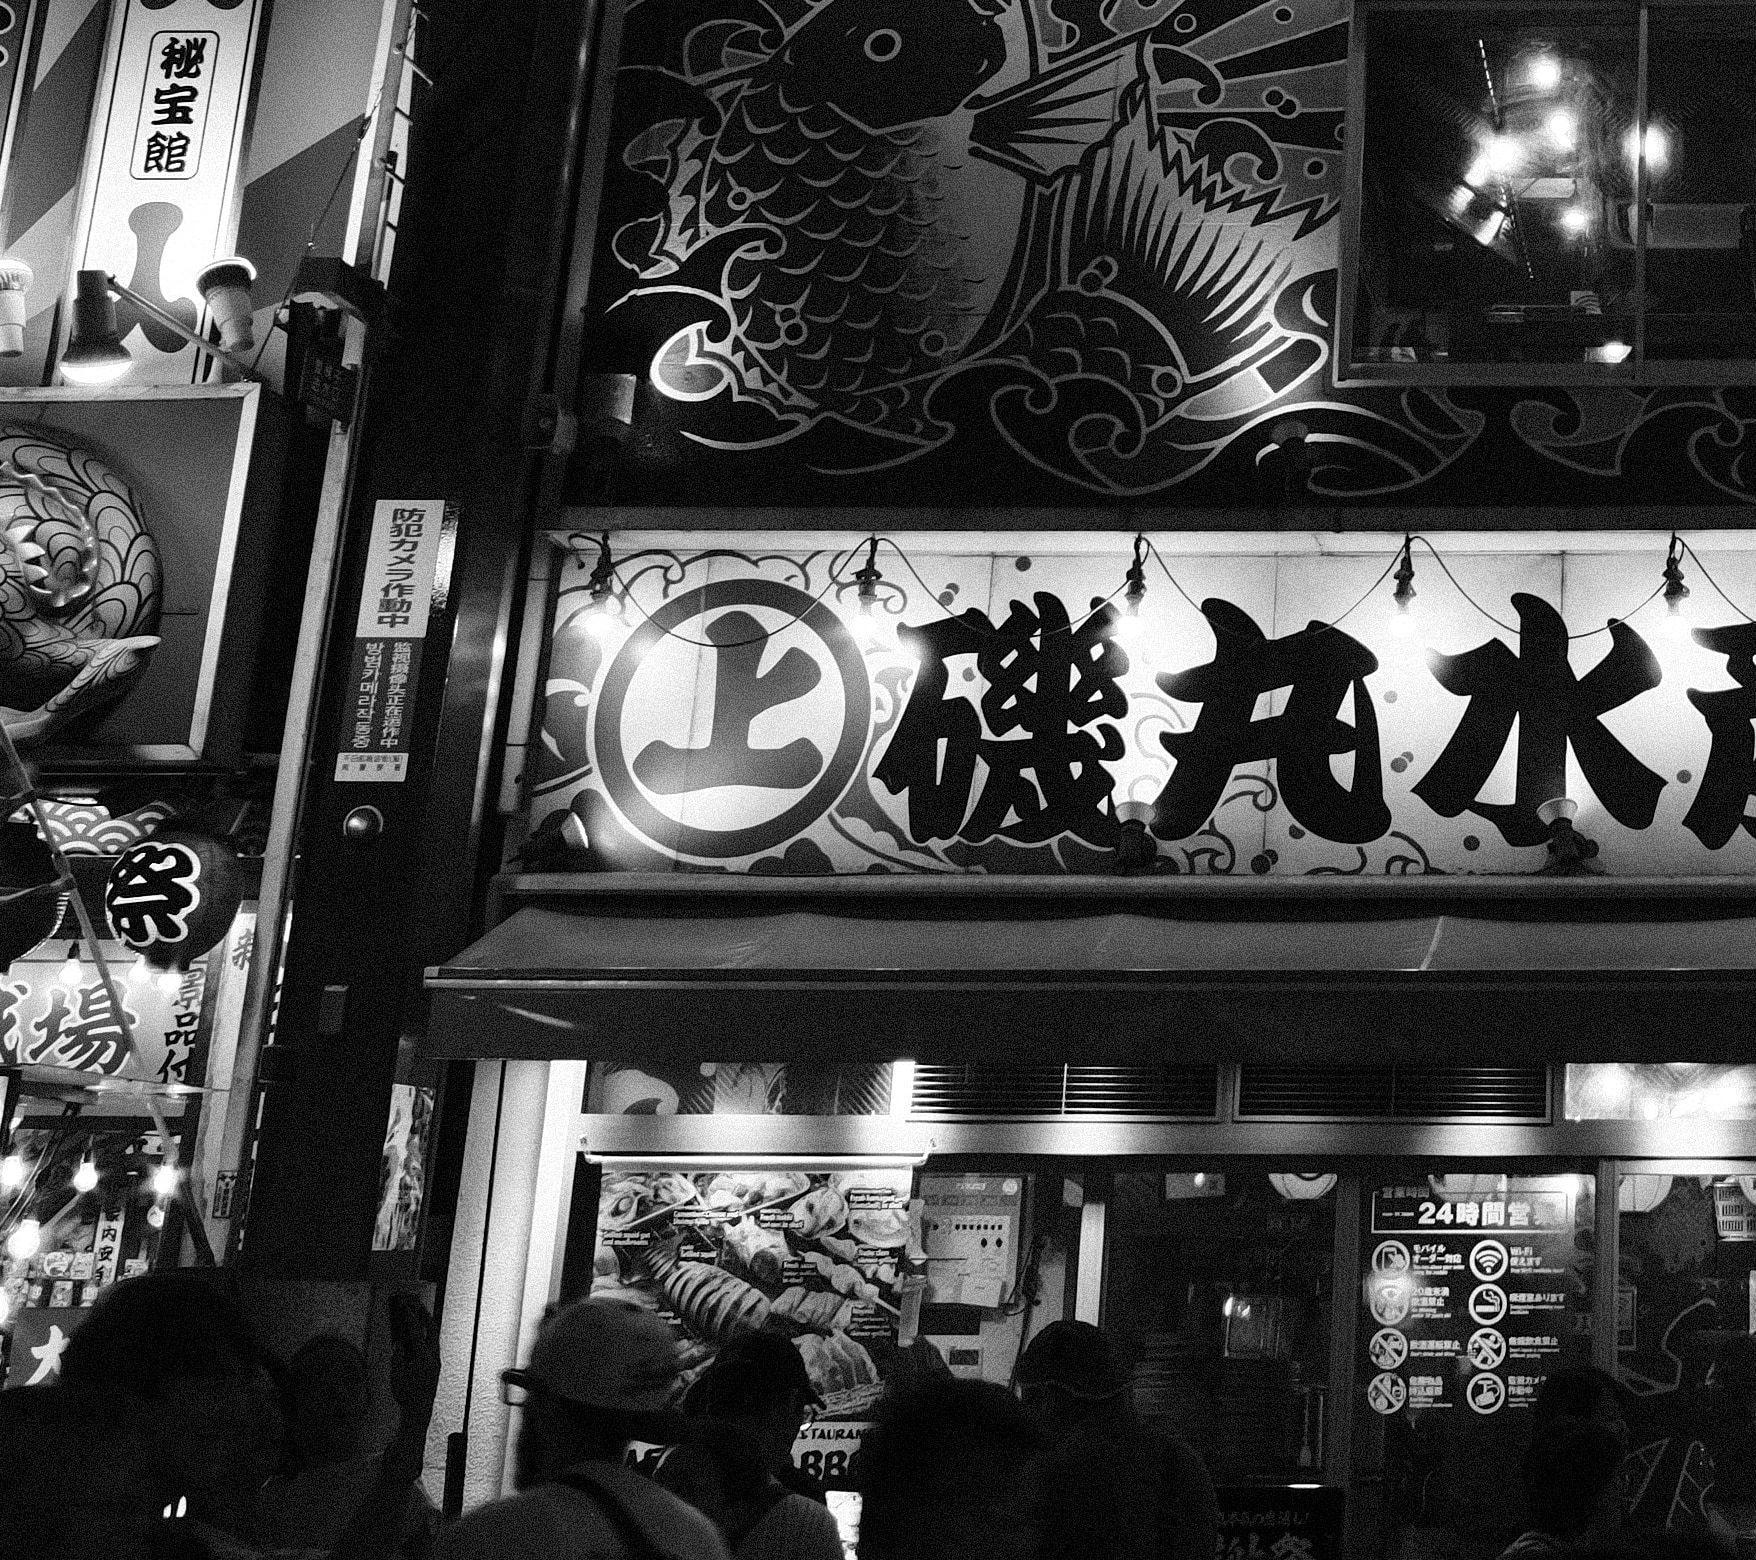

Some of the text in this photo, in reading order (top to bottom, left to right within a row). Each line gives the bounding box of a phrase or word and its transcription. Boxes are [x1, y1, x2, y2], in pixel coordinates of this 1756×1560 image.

[143, 36, 207, 175] 秘宝館
[377, 508, 426, 628] 防犯カメラ作動中
